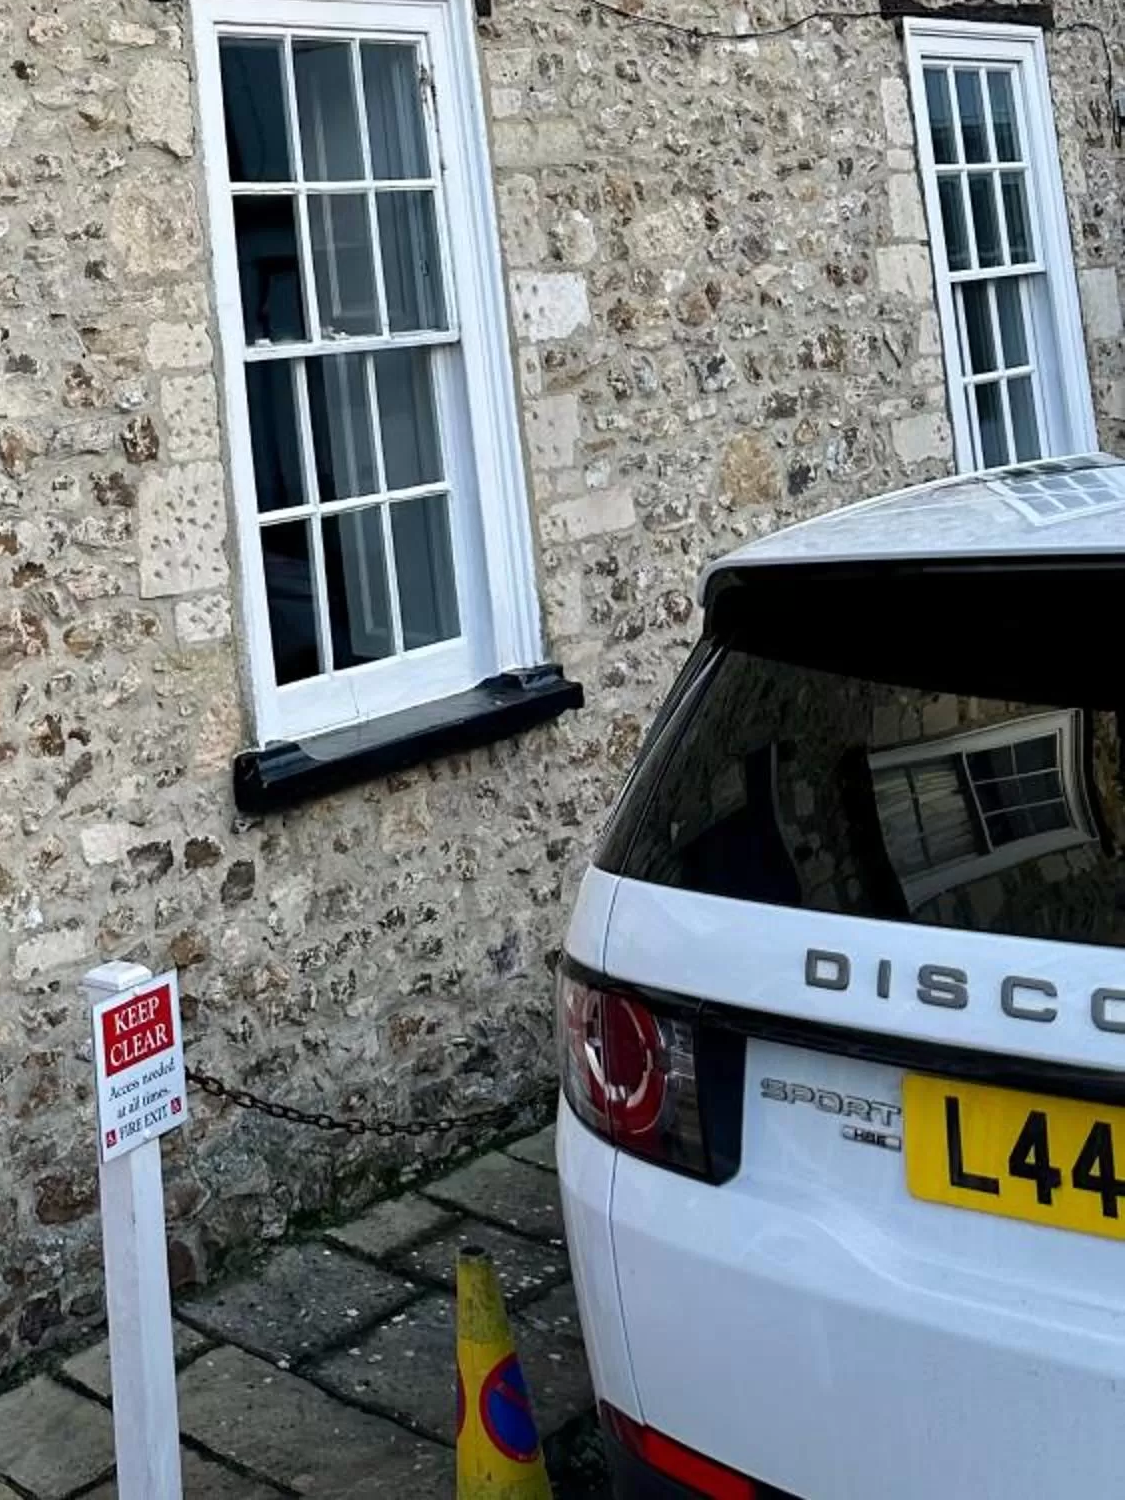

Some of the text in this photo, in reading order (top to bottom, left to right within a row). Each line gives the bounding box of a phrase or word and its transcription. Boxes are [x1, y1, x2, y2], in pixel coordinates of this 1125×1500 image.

[114, 996, 160, 1036] KEEP
[109, 1023, 169, 1067] CLEAR
[109, 1080, 140, 1102] Access
[760, 1076, 902, 1127] SPORT
[119, 1103, 168, 1141] FIRE EXIT
[944, 1095, 1125, 1220] L44
